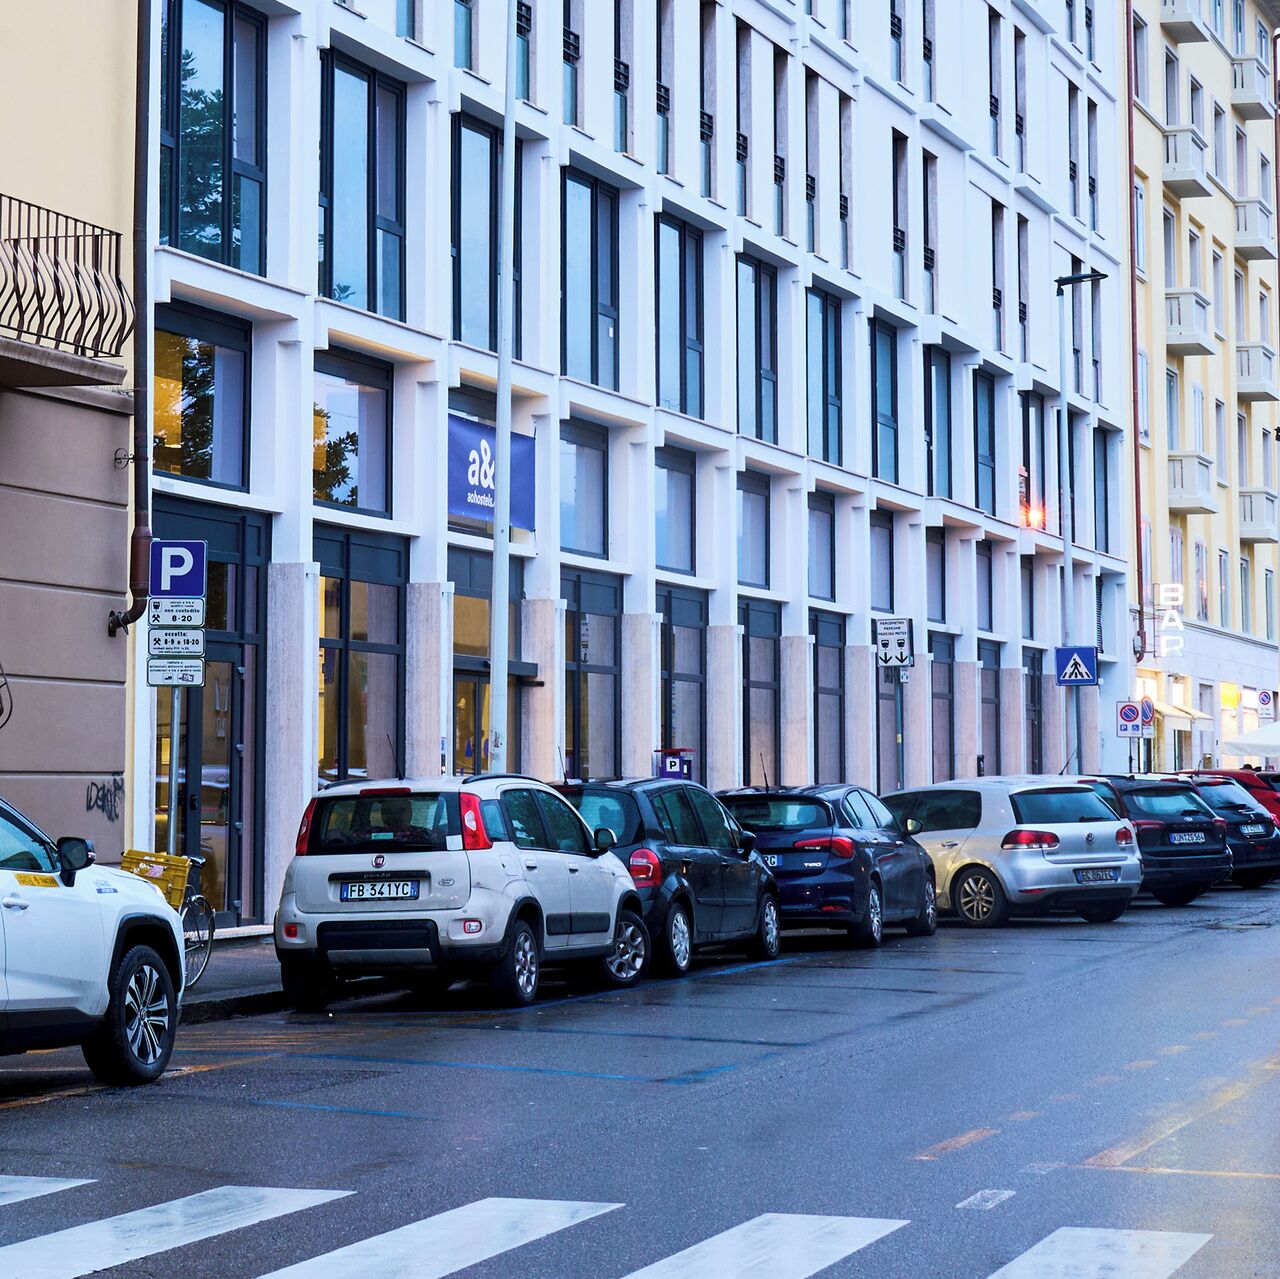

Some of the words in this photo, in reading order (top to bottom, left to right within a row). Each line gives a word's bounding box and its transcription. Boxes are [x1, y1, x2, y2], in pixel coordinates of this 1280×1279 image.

[467, 490, 496, 508] aohostels.
[161, 547, 194, 591] P
[1160, 583, 1185, 658] BAR
[349, 884, 365, 898] FB
[369, 882, 410, 897] 341YC
